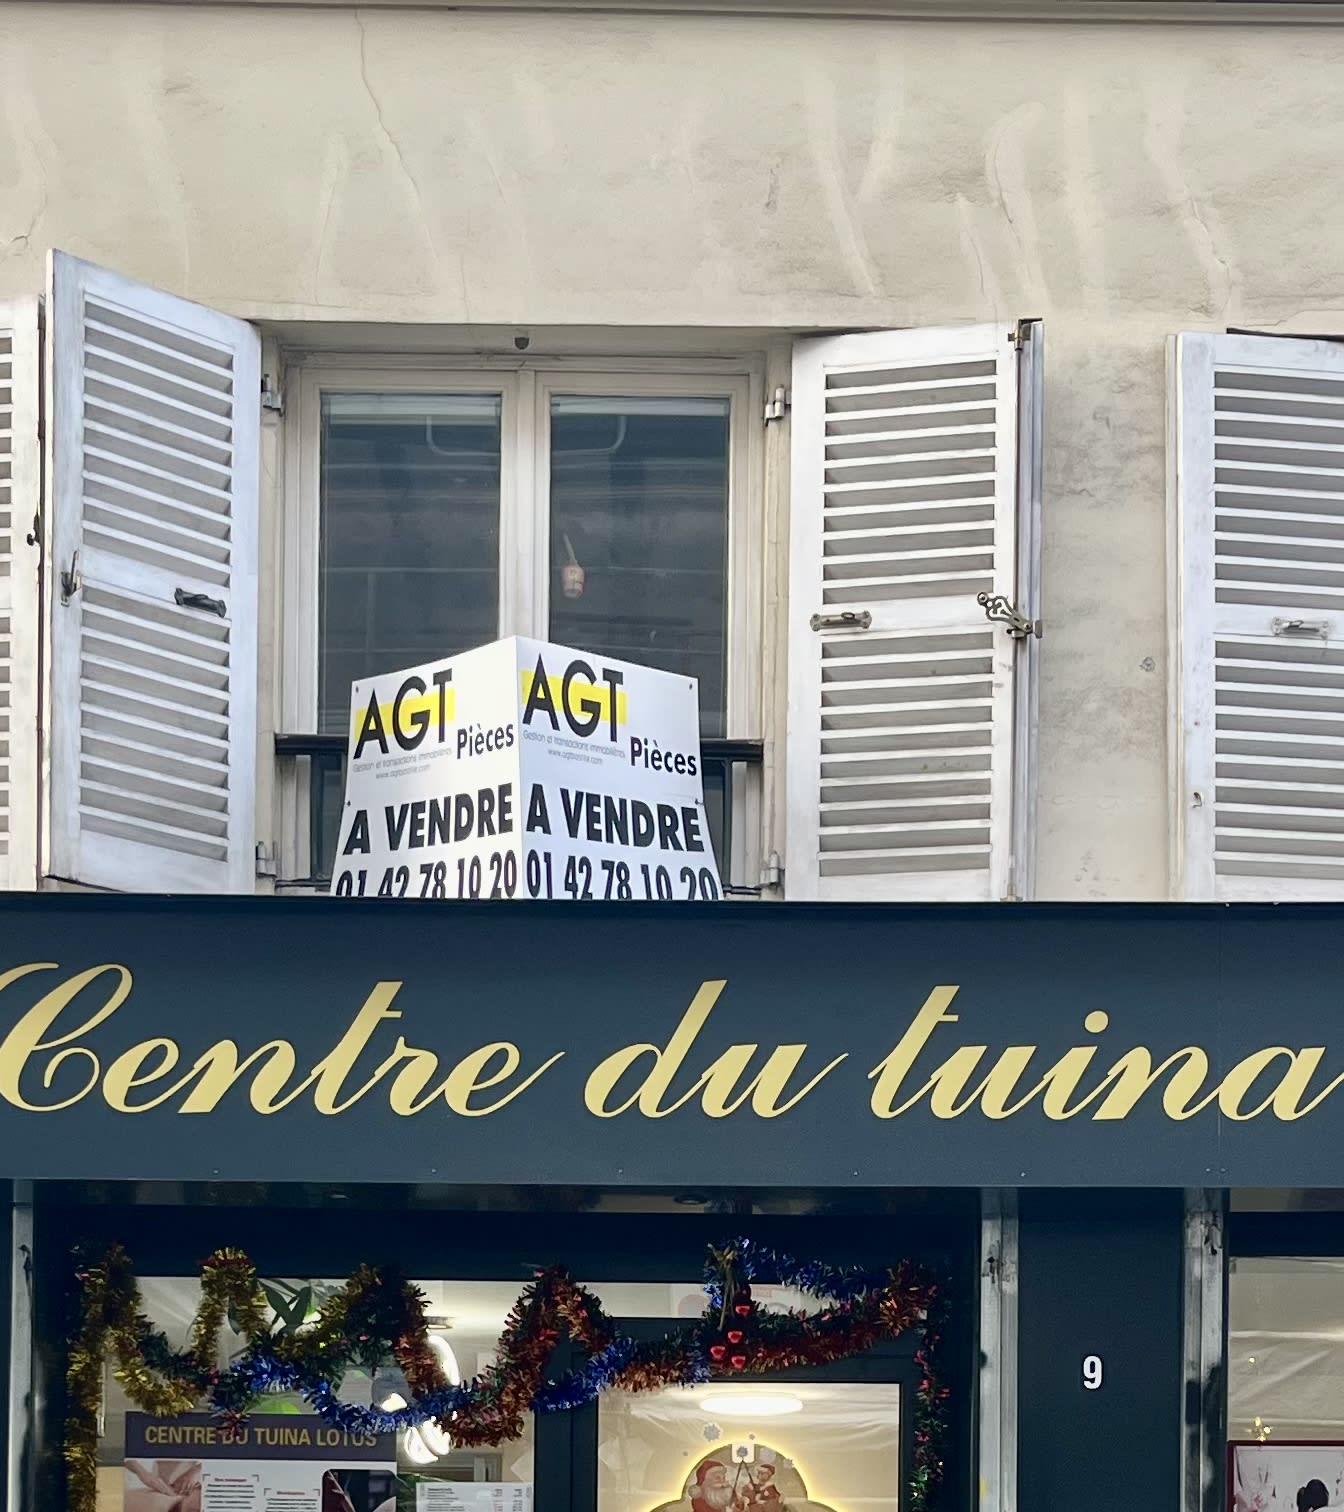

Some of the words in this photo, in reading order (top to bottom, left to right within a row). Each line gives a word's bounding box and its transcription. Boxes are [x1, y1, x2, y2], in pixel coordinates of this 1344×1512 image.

[353, 667, 453, 760] AGT
[522, 653, 624, 743] AGT
[457, 723, 514, 759] Pièces
[630, 735, 697, 776] Pièces
[342, 809, 371, 856] A
[384, 782, 513, 852] VENDRE
[526, 783, 552, 835] A
[560, 787, 705, 853] VENDRE
[336, 869, 368, 897] 01
[378, 865, 409, 898] 42
[419, 861, 447, 898] 78
[457, 855, 480, 899] 10
[489, 849, 517, 899] 20
[526, 849, 553, 899] 01
[564, 855, 593, 899] 42
[601, 860, 631, 900] 78
[641, 864, 670, 900] 10
[679, 866, 718, 900] 20
[582, 979, 849, 1119] du
[1083, 1355, 1103, 1389] 9
[145, 1426, 217, 1445] CENTRE
[255, 1428, 311, 1446] TUINA
